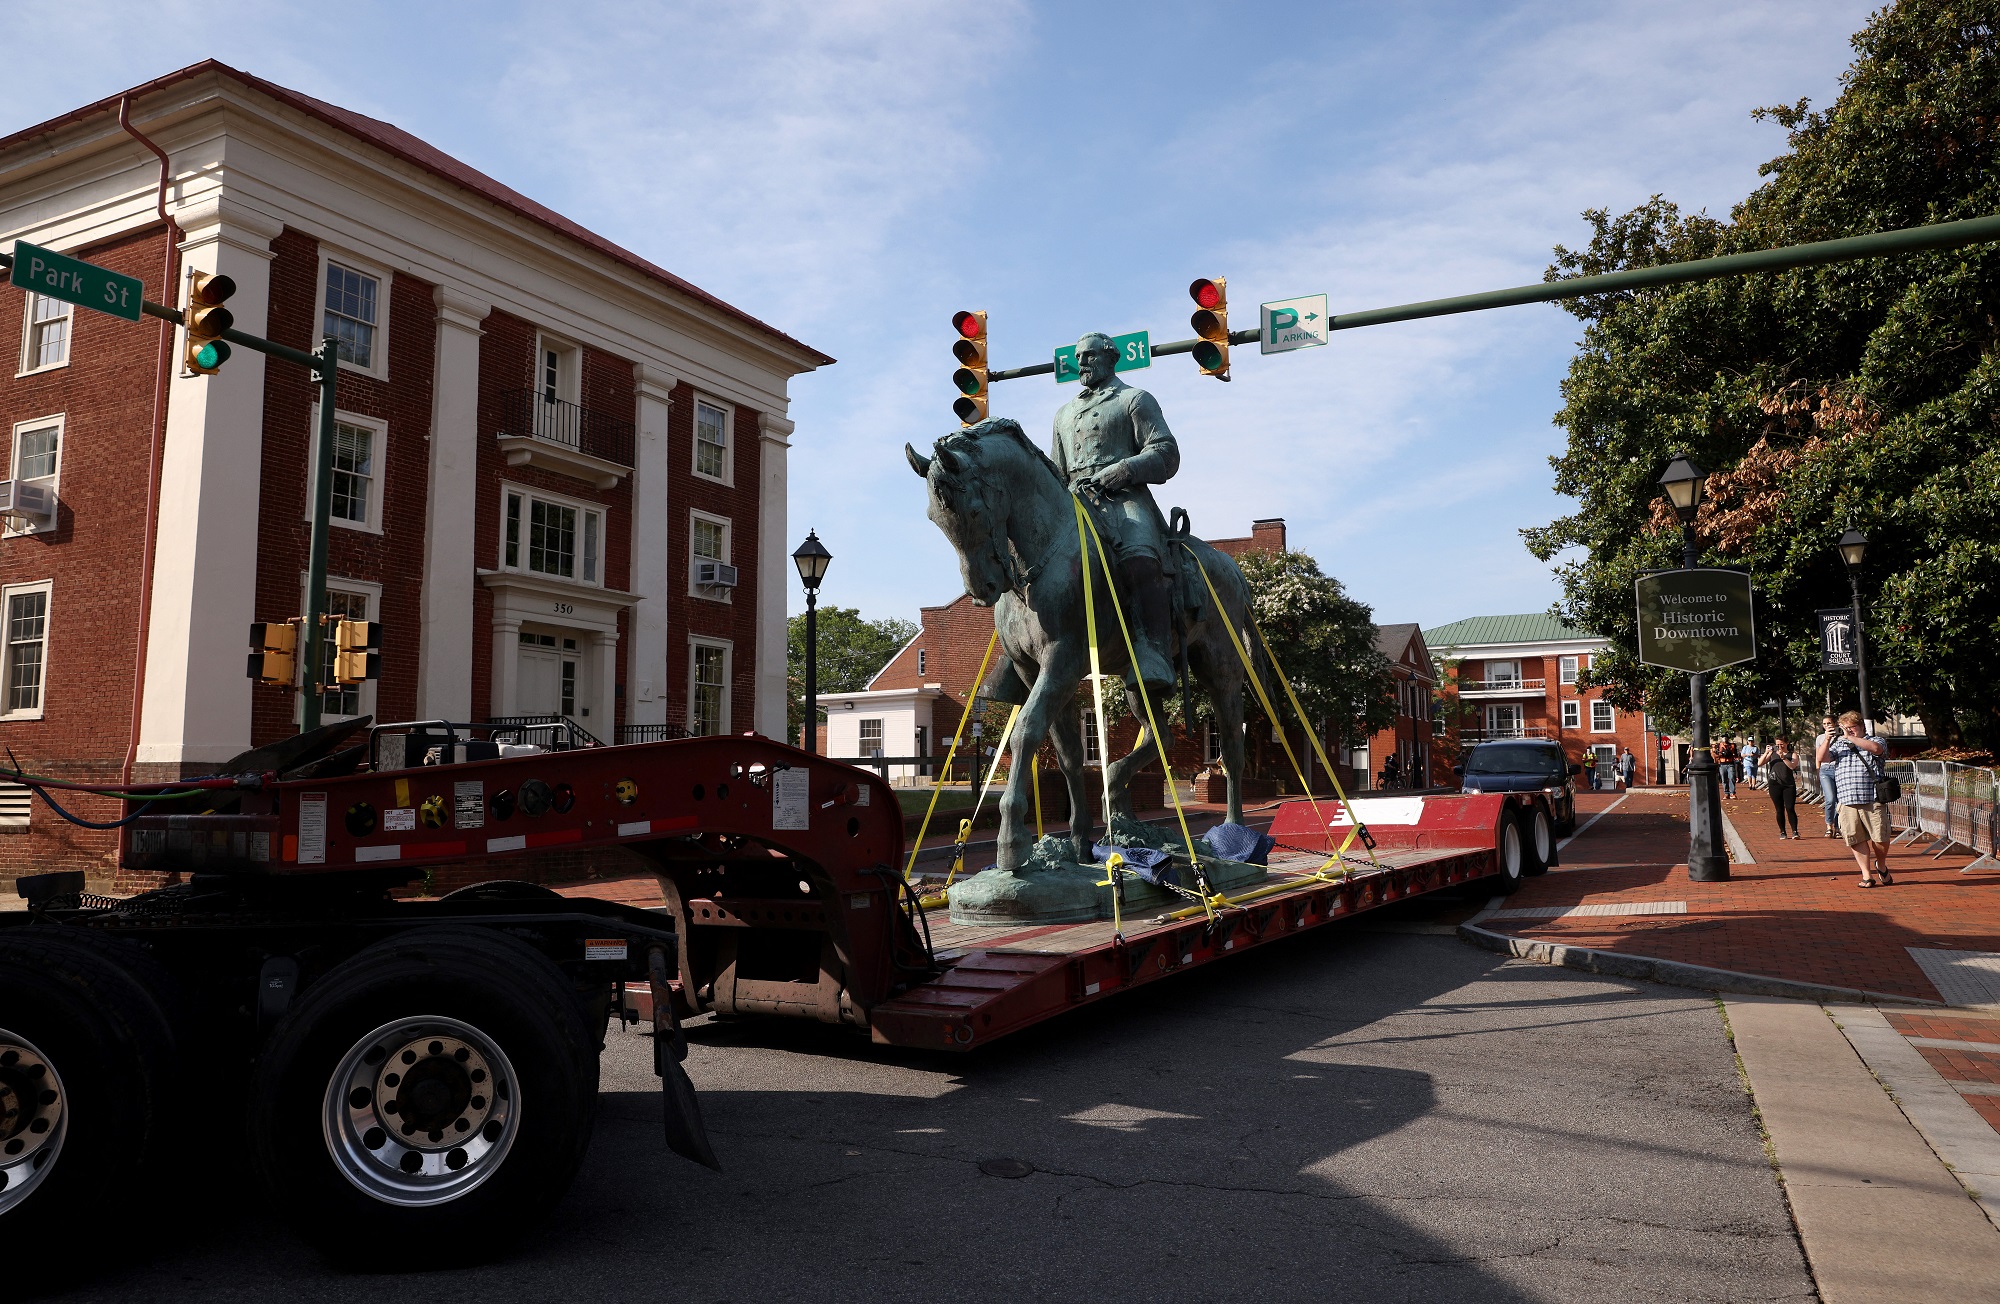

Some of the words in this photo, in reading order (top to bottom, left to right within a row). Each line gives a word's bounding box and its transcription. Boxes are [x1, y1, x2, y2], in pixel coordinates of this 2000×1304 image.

[30, 257, 83, 294] Park
[104, 281, 129, 308] St
[1059, 354, 1069, 374] E
[1126, 340, 1145, 361] St
[1660, 593, 1713, 605] Welcome
[1715, 593, 1727, 602] to
[553, 602, 573, 614] 350
[1662, 609, 1725, 625] Historic
[1653, 626, 1739, 640] Downtown
